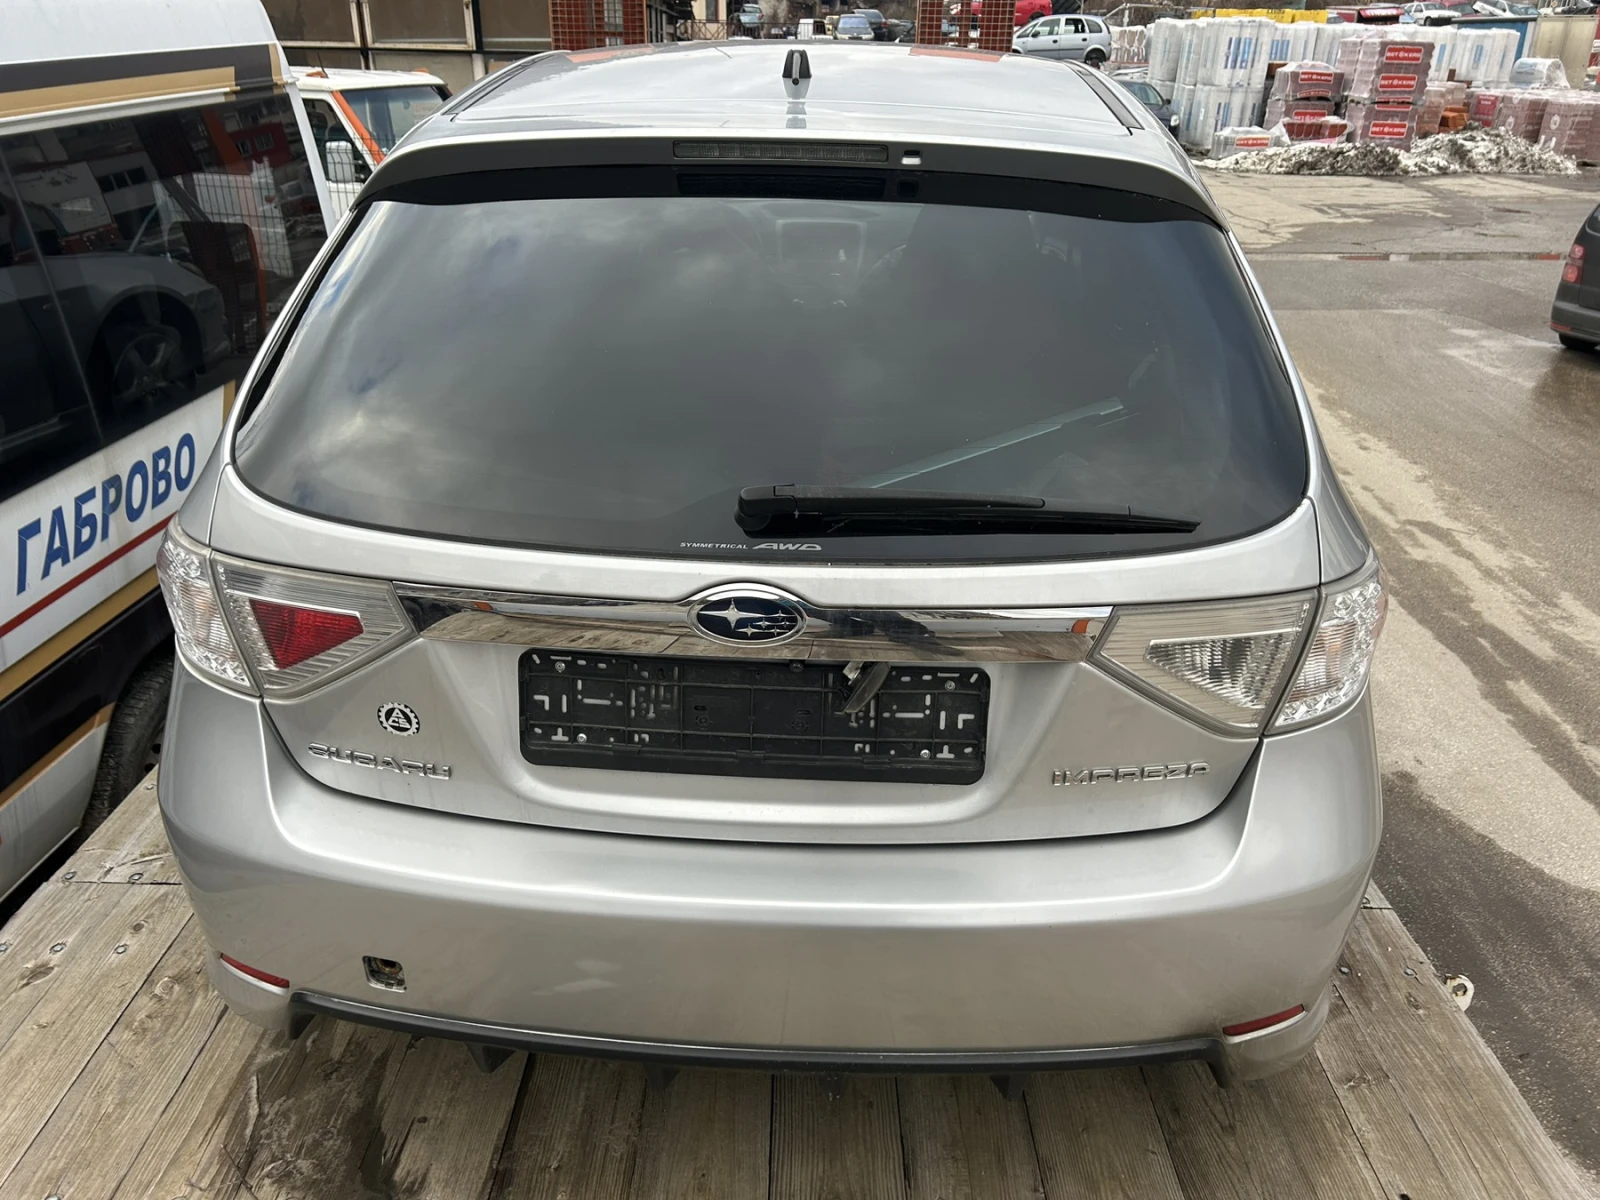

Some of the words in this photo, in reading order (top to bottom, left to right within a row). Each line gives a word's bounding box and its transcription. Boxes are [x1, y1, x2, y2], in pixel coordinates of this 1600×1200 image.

[17, 433, 195, 596] ГАБРОВО
[680, 541, 748, 549] SYMMETRICAL
[752, 542, 822, 551] AWD
[308, 742, 452, 780] SUBARU
[1052, 759, 1211, 786] IMPREZA
